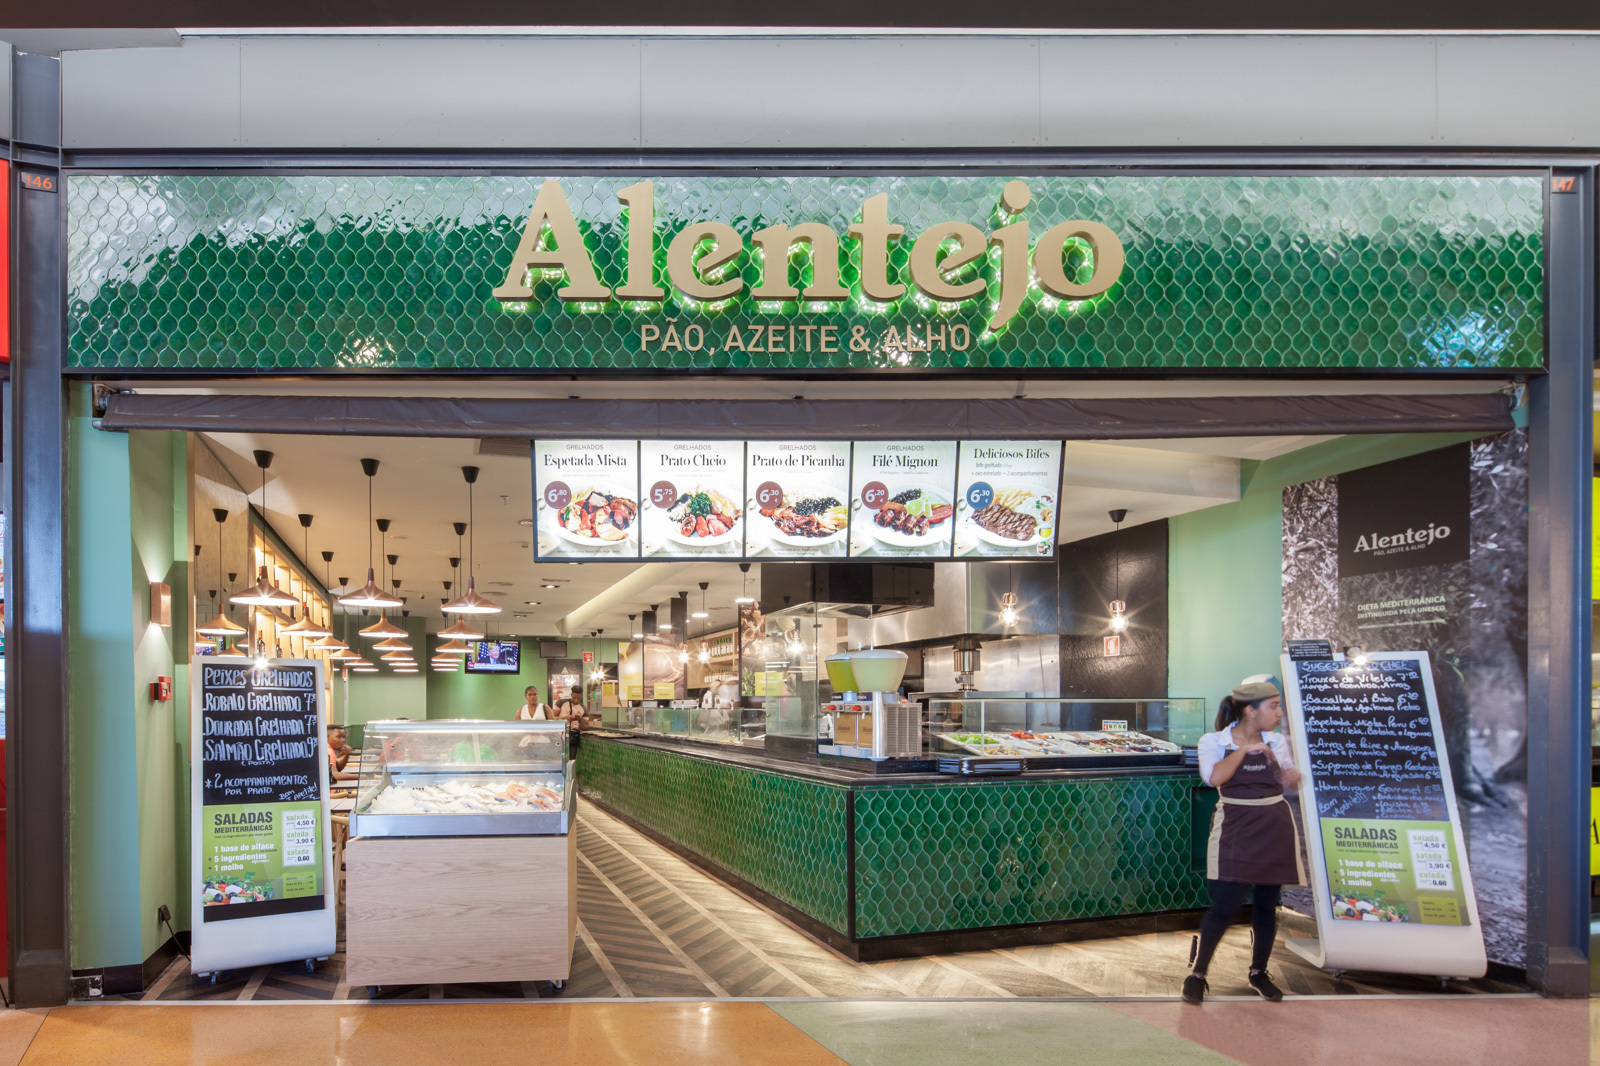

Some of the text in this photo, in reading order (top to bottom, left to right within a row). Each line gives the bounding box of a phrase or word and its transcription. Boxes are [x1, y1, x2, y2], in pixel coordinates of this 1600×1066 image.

[26, 175, 53, 190] 146
[1552, 178, 1575, 191] 147
[491, 179, 1126, 334] Alentejo
[640, 316, 971, 357] PÃO, AZEITE & ALHO
[565, 443, 604, 451] GRELHADOS
[886, 444, 925, 452] GRELHADOS
[973, 447, 1051, 460] Deliciosos Bifes
[543, 453, 628, 470] Espetada Mista
[660, 453, 727, 467] Prato Cheio
[752, 454, 846, 467] Prato de Picanha
[872, 454, 939, 471] Filé Mignon
[1353, 522, 1451, 553] Alentejo
[1386, 546, 1405, 555] AZEITE
[1410, 543, 1426, 551] ALHO
[1357, 595, 1446, 612] DIETA MEDITERRÂNICA
[1357, 609, 1399, 619] DISTINGUIDA
[1417, 604, 1446, 613] UNESCO
[1380, 660, 1408, 671] CHEF
[1341, 673, 1354, 684] de
[1355, 673, 1396, 684] Vitela
[1344, 739, 1357, 750] de
[225, 786, 243, 796] POR
[214, 811, 274, 826] SALADAS
[296, 819, 310, 827] 4,50
[214, 824, 273, 834] MEDITERRÂNICAS
[286, 830, 309, 839] salada
[1334, 826, 1398, 842] SALADAS
[295, 837, 310, 845] 3,90
[1412, 834, 1439, 842] salada
[214, 845, 219, 853] 1
[220, 843, 239, 852] base
[240, 843, 250, 851] de
[251, 842, 274, 851] alface
[1335, 840, 1399, 850] MEDITERRÂNICAS
[1423, 842, 1441, 850] 4,50
[286, 848, 310, 856] salada
[1415, 852, 1443, 860] salada
[214, 855, 220, 863] 5
[220, 853, 267, 865] ingredientes
[1338, 858, 1403, 870] 1 base de alface
[214, 864, 219, 872] 1
[220, 863, 244, 872] molho
[1427, 862, 1445, 870] 3,90
[1339, 868, 1345, 877] 5
[1347, 868, 1397, 880] ingredientes
[1418, 871, 1446, 879] salada
[1341, 878, 1346, 886] 1
[1348, 878, 1373, 887] molho
